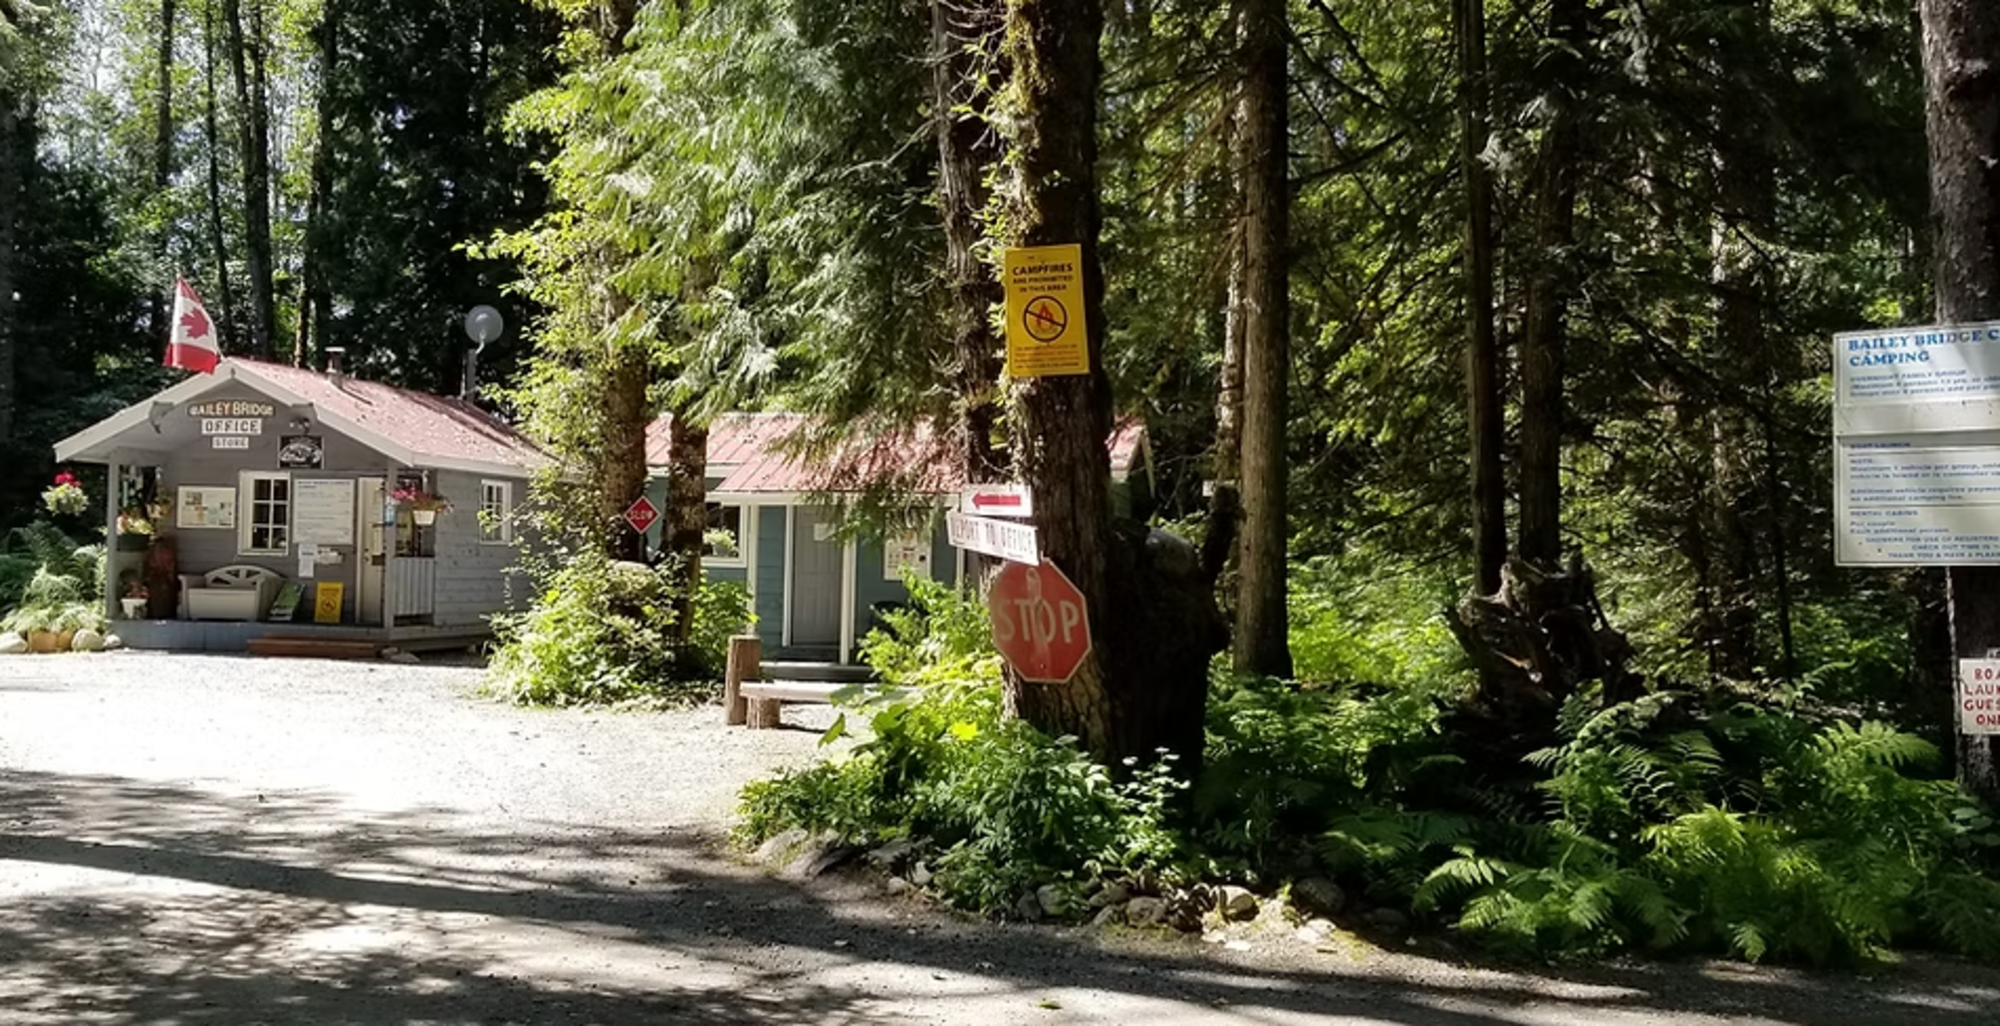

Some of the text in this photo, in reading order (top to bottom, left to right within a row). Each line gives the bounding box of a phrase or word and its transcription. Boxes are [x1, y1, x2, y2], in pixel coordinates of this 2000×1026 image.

[1013, 263, 1074, 276] CAMPFIRES
[1028, 274, 1074, 282] PROHIBITED
[1848, 336, 1910, 350] BAILEY
[1914, 331, 1982, 346] BRIDGE
[1850, 350, 1930, 367] CAMPING
[188, 401, 274, 415] BAILEY BRIDGE
[205, 420, 258, 432] OFFICE
[214, 438, 246, 447] STORE
[630, 510, 653, 520] SLOW
[996, 598, 1081, 645] STOP
